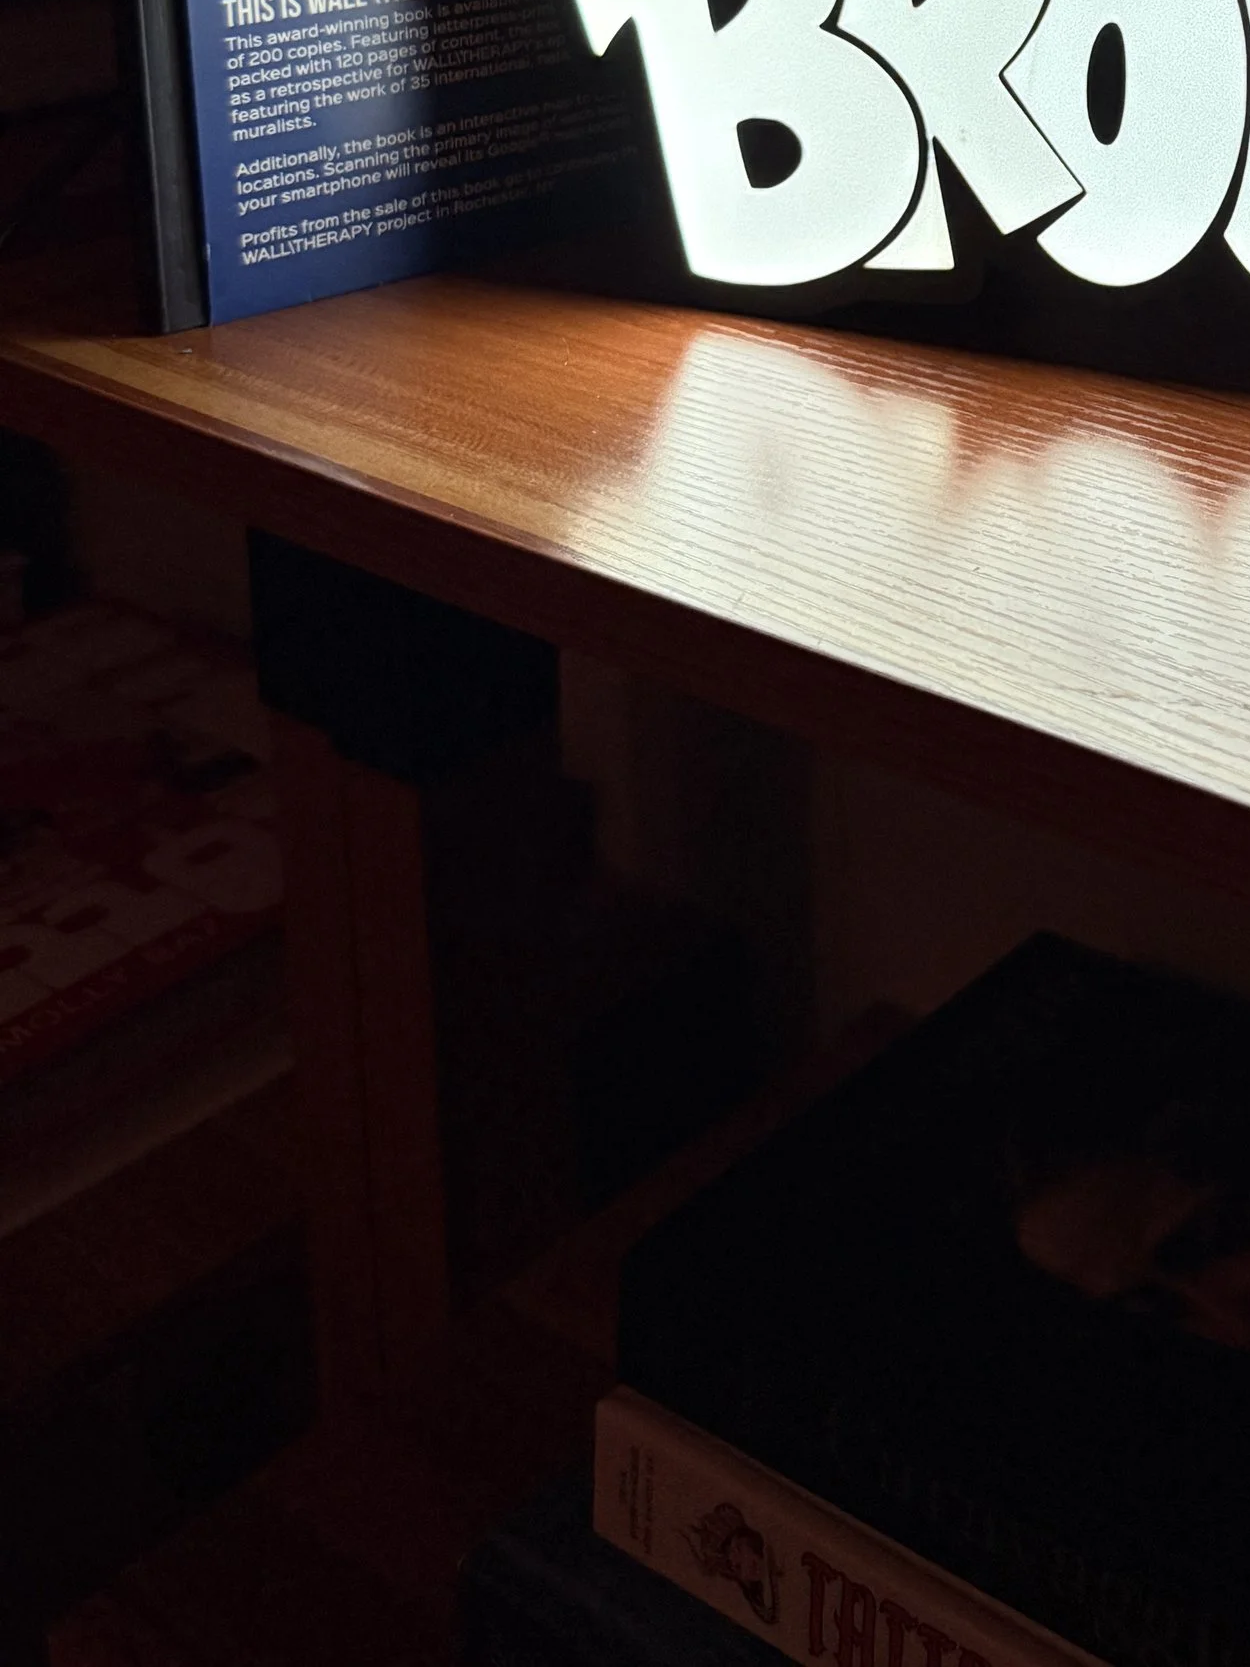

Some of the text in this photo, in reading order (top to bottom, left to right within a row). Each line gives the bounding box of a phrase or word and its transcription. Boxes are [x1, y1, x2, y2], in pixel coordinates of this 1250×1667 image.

[224, 33, 263, 52] This
[266, 13, 390, 46] award-winning
[393, 5, 434, 25] book
[437, 2, 450, 18] is
[227, 53, 245, 70] of
[248, 47, 283, 67] 200
[287, 39, 347, 60] copies.
[351, 24, 430, 49] Featuring
[229, 64, 292, 91] packed
[296, 57, 332, 76] with
[336, 52, 364, 69] 120
[368, 44, 418, 67] pages
[421, 39, 436, 54] of
[230, 91, 252, 107] as
[255, 89, 267, 102] a
[270, 68, 383, 99] retrospective
[386, 62, 409, 77] for
[231, 97, 310, 124] featuring
[314, 92, 343, 108] the
[346, 83, 387, 102] work
[390, 77, 406, 94] of
[410, 74, 431, 90] 35
[231, 115, 318, 142] muralists.
[235, 145, 341, 178] Additionally,
[344, 138, 372, 155] the
[376, 128, 416, 148] book
[420, 125, 433, 139] is
[436, 121, 456, 134] an
[236, 168, 320, 196] locations.
[323, 149, 399, 177] Scanning
[403, 143, 430, 160] the
[434, 130, 491, 155] primary
[237, 194, 278, 217] your
[281, 171, 382, 204] smartphone
[385, 162, 411, 181] will
[414, 150, 462, 174] reveal
[465, 148, 485, 162] its
[240, 224, 298, 249] Profits
[301, 215, 340, 234] from
[343, 207, 372, 224] the
[375, 198, 408, 218] sale
[412, 190, 428, 208] of
[431, 187, 460, 204] this
[241, 221, 373, 266] WALL\THERAPY
[377, 210, 432, 237] project
[436, 204, 450, 219] in
